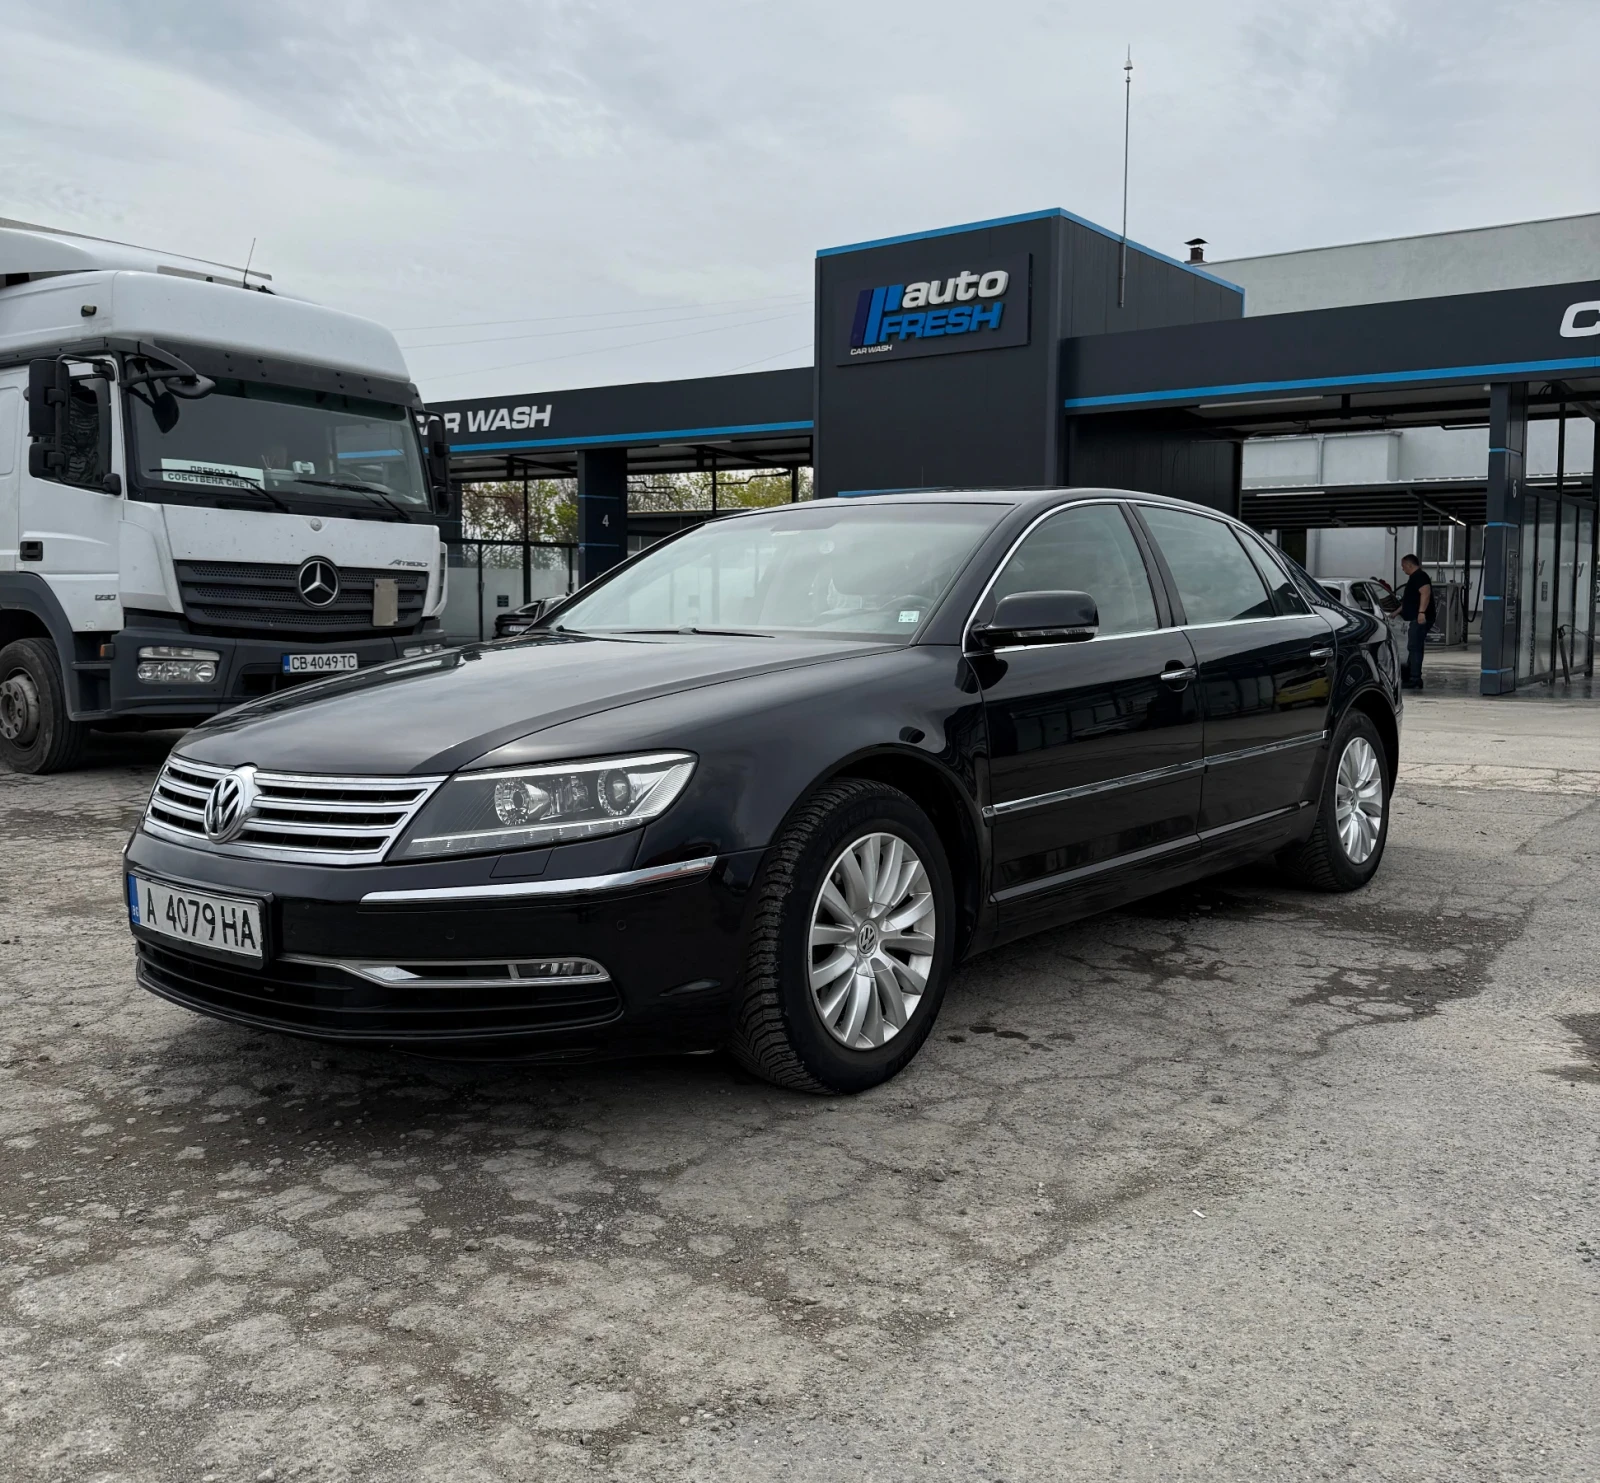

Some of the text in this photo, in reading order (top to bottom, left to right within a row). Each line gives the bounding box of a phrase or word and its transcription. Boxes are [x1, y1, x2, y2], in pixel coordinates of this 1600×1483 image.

[902, 270, 1009, 308] auto
[879, 301, 1003, 343] FRESH
[868, 344, 893, 353] WASH
[467, 404, 552, 432] WASH
[602, 514, 610, 528] 4
